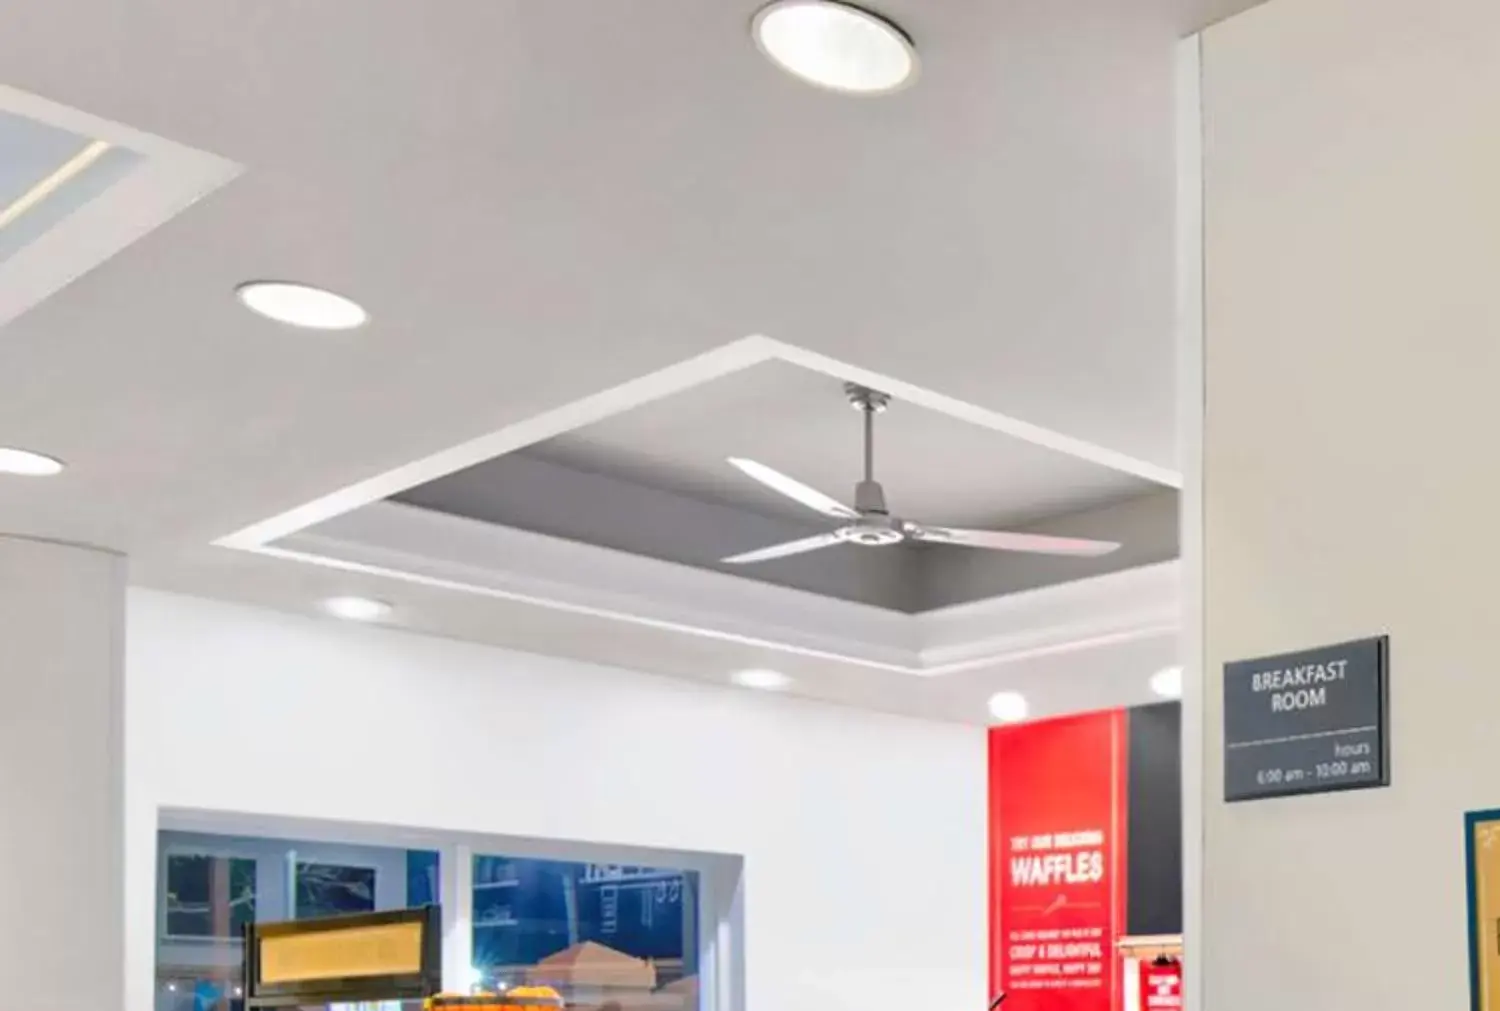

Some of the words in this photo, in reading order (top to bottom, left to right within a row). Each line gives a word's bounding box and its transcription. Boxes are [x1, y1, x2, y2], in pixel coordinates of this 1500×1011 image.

[1252, 660, 1347, 692] BREAKFAST
[1271, 687, 1327, 712] ROOM
[1334, 741, 1371, 757] hours
[1256, 768, 1283, 784] 6:00
[1285, 769, 1304, 783] am
[1316, 762, 1348, 778] 10:00
[1350, 761, 1371, 774] am
[1010, 850, 1103, 887] WAFFLES
